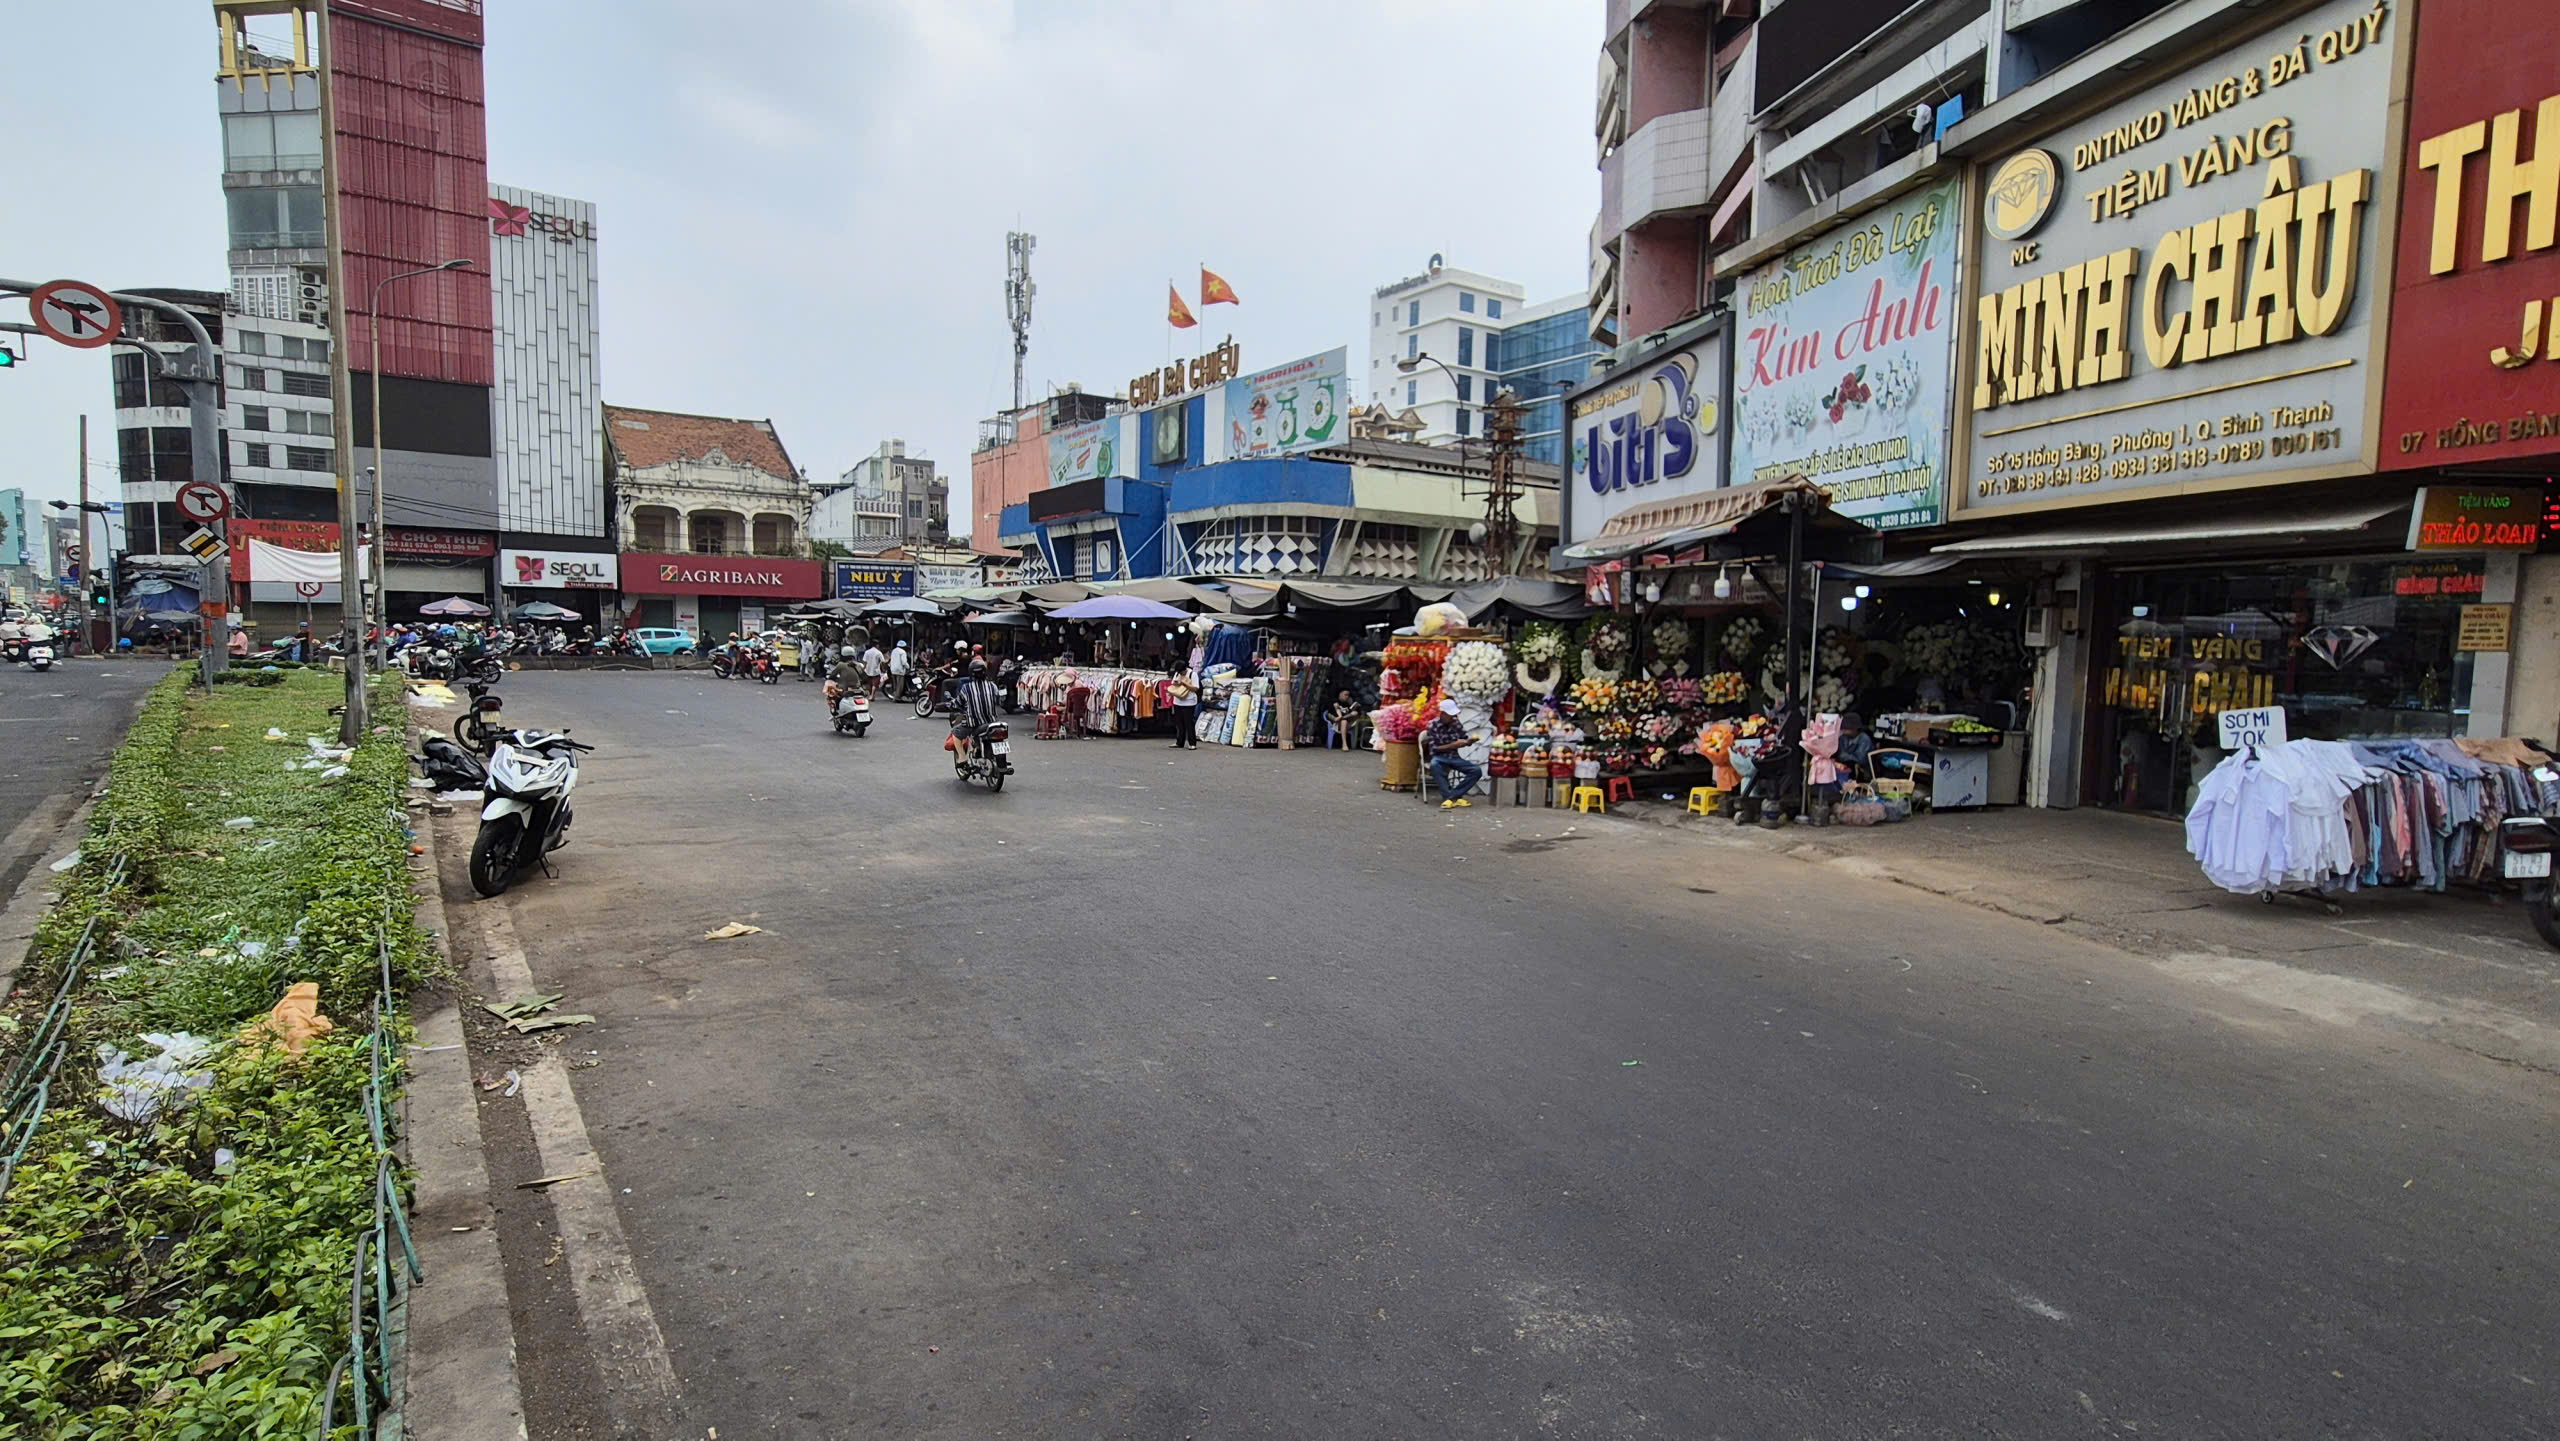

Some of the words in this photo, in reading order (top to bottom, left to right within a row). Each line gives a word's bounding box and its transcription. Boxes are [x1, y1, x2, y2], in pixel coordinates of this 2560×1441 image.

[2073, 109, 2164, 172] DNTNKD
[2169, 77, 2239, 128] VÀNG
[2241, 67, 2262, 98] &
[2268, 35, 2310, 88] ĐÁ
[2315, 1, 2387, 65] QUÝ
[2085, 163, 2170, 223] TIỆM
[2177, 116, 2294, 188] VÀNG
[528, 212, 589, 240] SEOUL
[1749, 273, 1790, 319] Hoa
[1796, 241, 1843, 296] Tươi
[1846, 224, 1884, 273] Đà
[1889, 201, 1939, 254] Lạt
[2010, 241, 2041, 268] MC
[1973, 247, 2140, 411] MINH
[2143, 154, 2372, 370] CHÂU
[1738, 322, 1823, 393] Kim
[1834, 257, 1943, 361] Anh
[1129, 367, 1161, 409] CHỢ
[1163, 358, 1186, 397] BÀ
[1844, 443, 1864, 469] CÁC
[1865, 440, 1886, 469] LOẠI
[1887, 435, 1908, 462] HOA
[1987, 452, 2007, 474] Số
[2007, 452, 2024, 470] 05
[2025, 443, 2062, 467] Hồng
[2196, 420, 2217, 441] Q.
[2220, 410, 2263, 437] Bình
[2271, 400, 2333, 428] Thạnh
[2399, 431, 2427, 453] 07
[2435, 417, 2500, 449] HỒNG
[1843, 477, 1867, 502] SINH
[1867, 469, 1893, 501] NHẬT
[1893, 469, 1911, 498] ĐẠI
[1912, 460, 1931, 496] HỘI
[2028, 470, 2045, 490] 38
[2075, 463, 2101, 483] 428
[2110, 456, 2148, 480] 0934
[2181, 447, 2209, 470] 313
[2483, 492, 2512, 508] VÀNG
[400, 532, 438, 544] CHO
[2423, 516, 2481, 544] THẢO
[2483, 522, 2537, 544] LOAN
[550, 562, 605, 578] SEOUL
[681, 570, 784, 586] AGRIBANK
[850, 571, 888, 584] NHƯ
[2191, 632, 2263, 661] VÀNG
[2225, 712, 2250, 730] SƠ
[2253, 710, 2270, 727] MI
